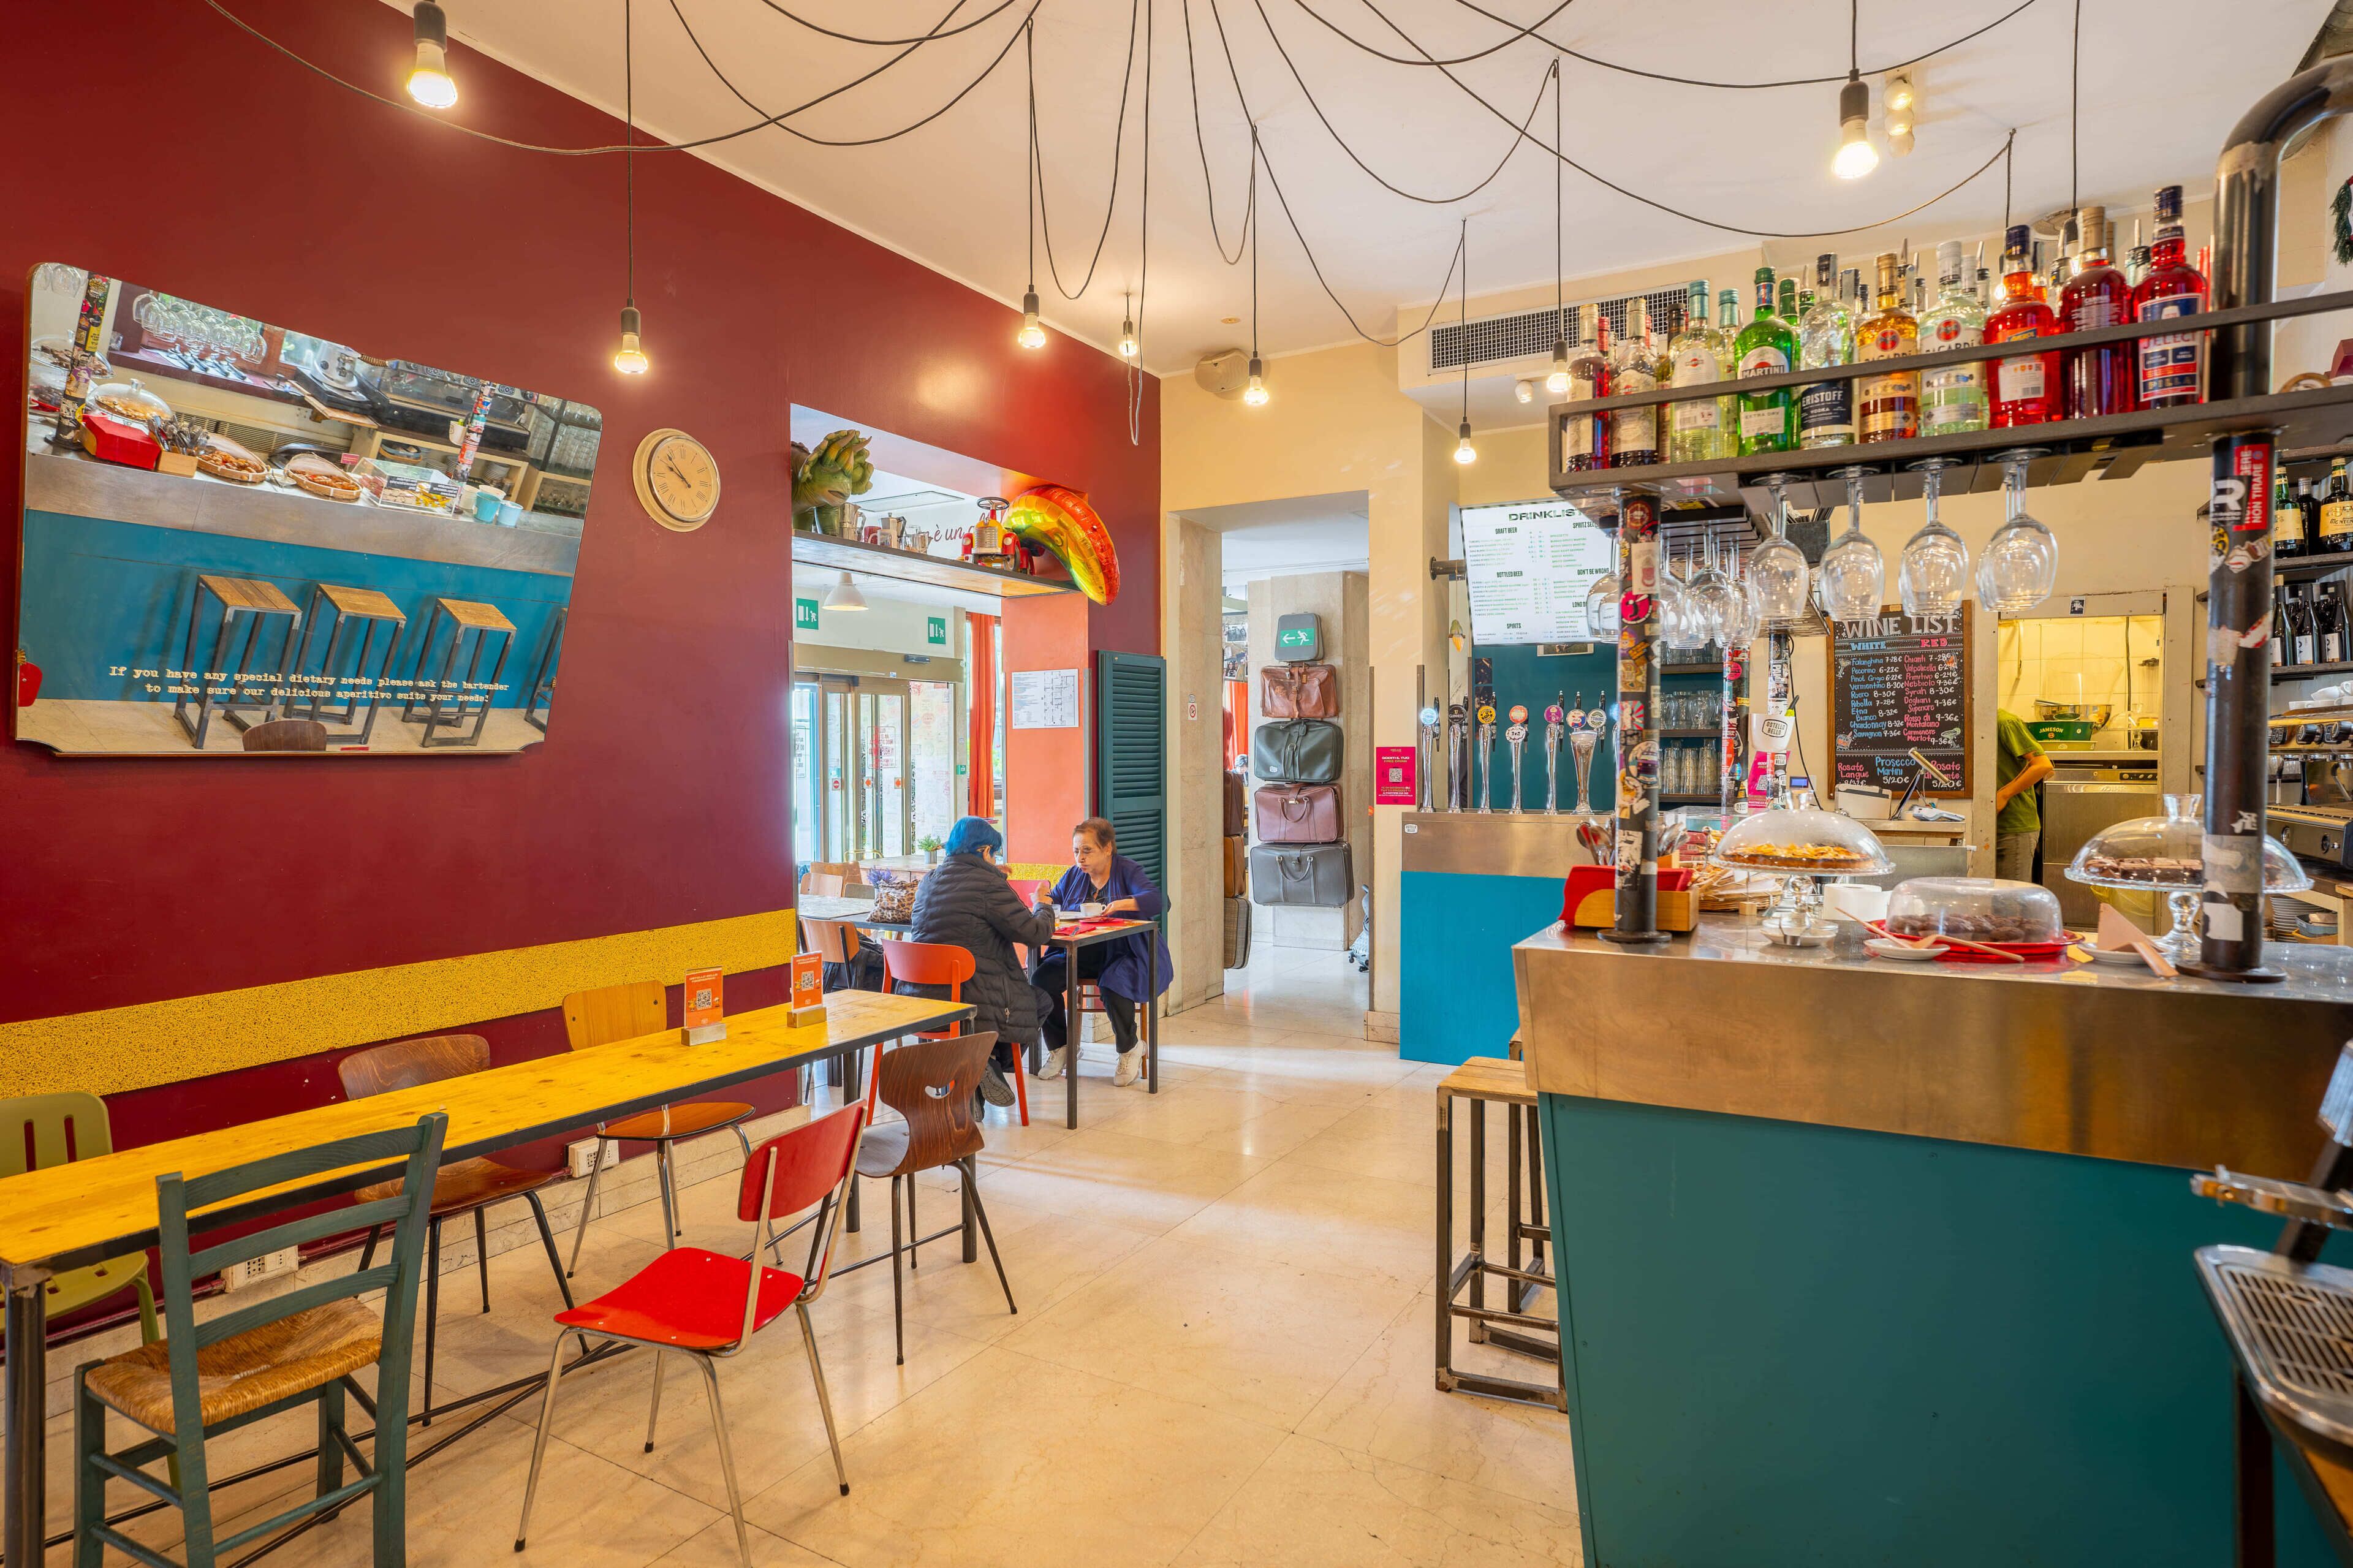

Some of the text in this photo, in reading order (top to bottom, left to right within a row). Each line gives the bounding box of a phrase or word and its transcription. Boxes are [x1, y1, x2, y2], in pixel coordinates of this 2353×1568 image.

[1742, 365, 1785, 379] MARTINI
[1802, 391, 1843, 407] ERISTOFF
[2251, 463, 2264, 524] NON TIRARE
[934, 524, 942, 542] è
[945, 526, 963, 541] un
[1842, 615, 1958, 638] WINE LIST
[1849, 641, 1887, 651] WHITE
[1920, 637, 1948, 648] RED
[1852, 657, 1884, 667] Falanghina
[1904, 654, 1926, 663] Chianti
[109, 665, 510, 691] If you have any special dietary needs please ask the bartender
[1868, 675, 1885, 683] Grigio
[1906, 672, 1933, 681] Primitivo
[1849, 681, 1885, 691] Vermentino
[1904, 679, 1935, 687] Nebbiolo
[144, 683, 489, 703] to make sure our delicious aperitivo suits your needs!
[1904, 686, 1955, 697] Syrah 8-30€
[1851, 697, 1873, 708] Ribolla
[1904, 696, 1957, 707] Dogliani 9-36€
[1904, 714, 1922, 722] Rosso
[1923, 712, 1931, 721] di
[1766, 721, 1786, 730] OSTELLO
[1849, 721, 1887, 730] Chardonnay
[1838, 762, 1865, 771] Rosate
[1875, 756, 1917, 767] Prosecco
[1876, 767, 1903, 776] Martini
[1882, 776, 1909, 784] 5/20€
